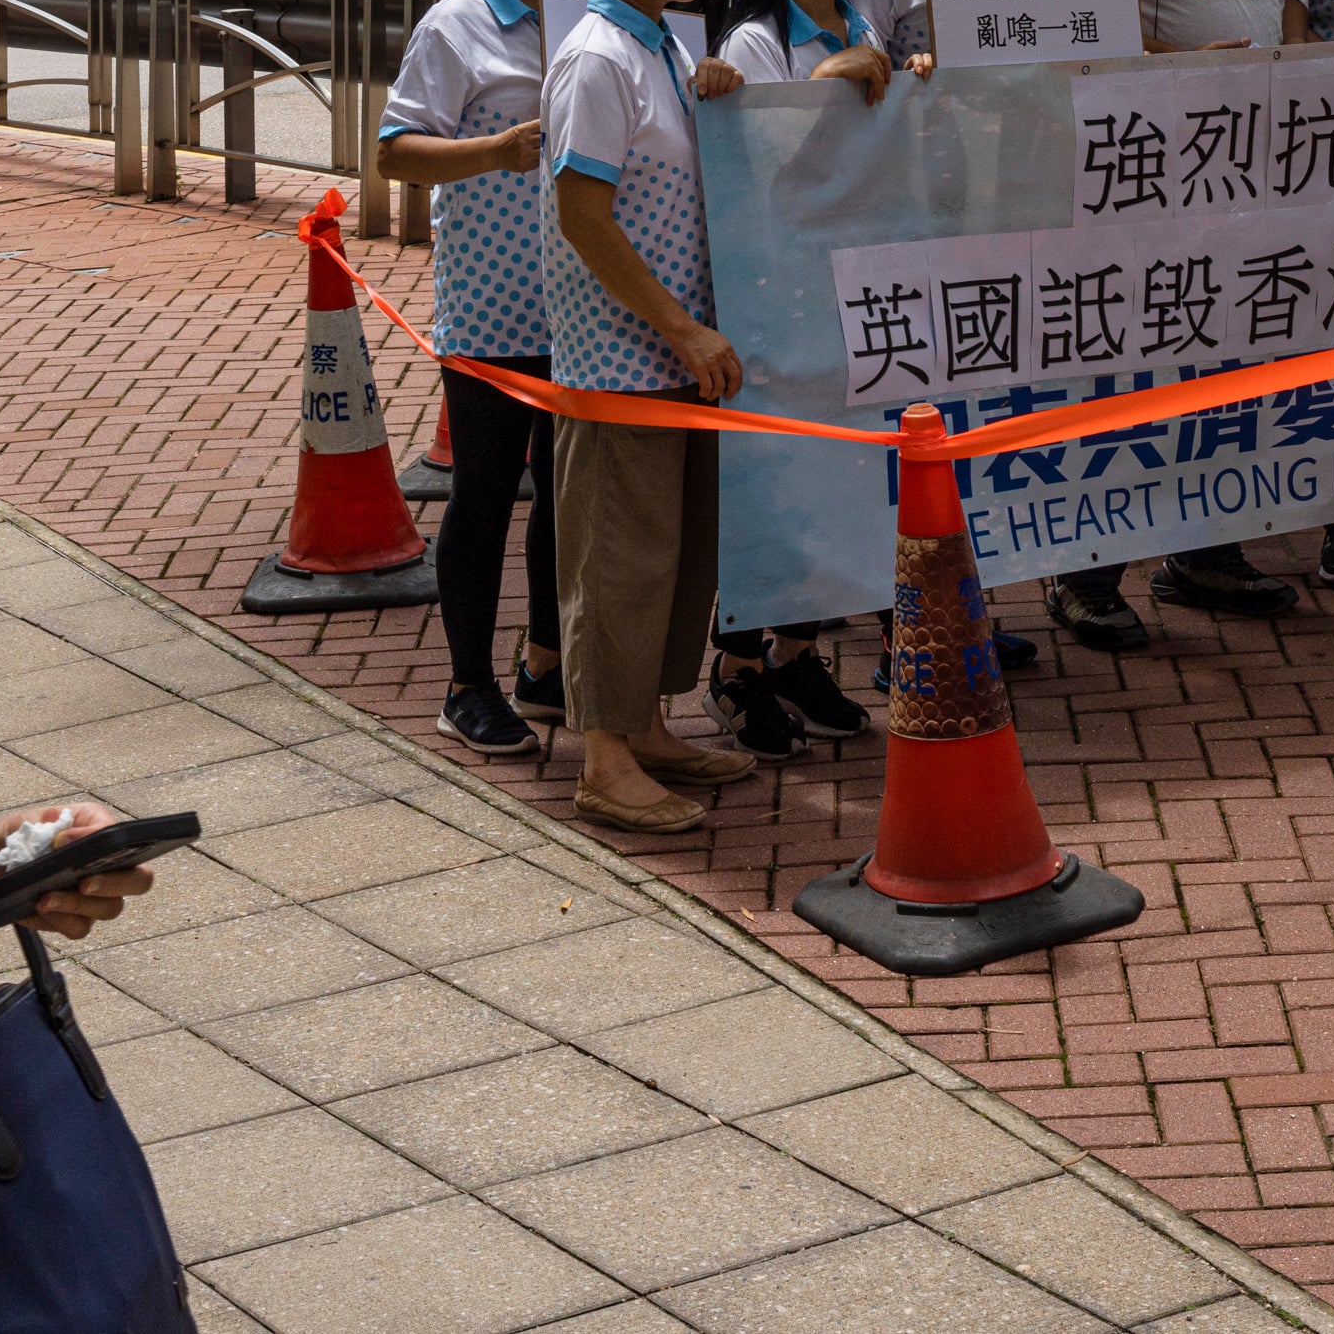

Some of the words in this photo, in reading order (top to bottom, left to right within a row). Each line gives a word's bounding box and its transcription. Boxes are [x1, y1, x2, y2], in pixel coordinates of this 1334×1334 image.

[976, 11, 1100, 49] 亂噏一通
[1008, 481, 1162, 552] HEART
[1178, 457, 1318, 523] HONG
